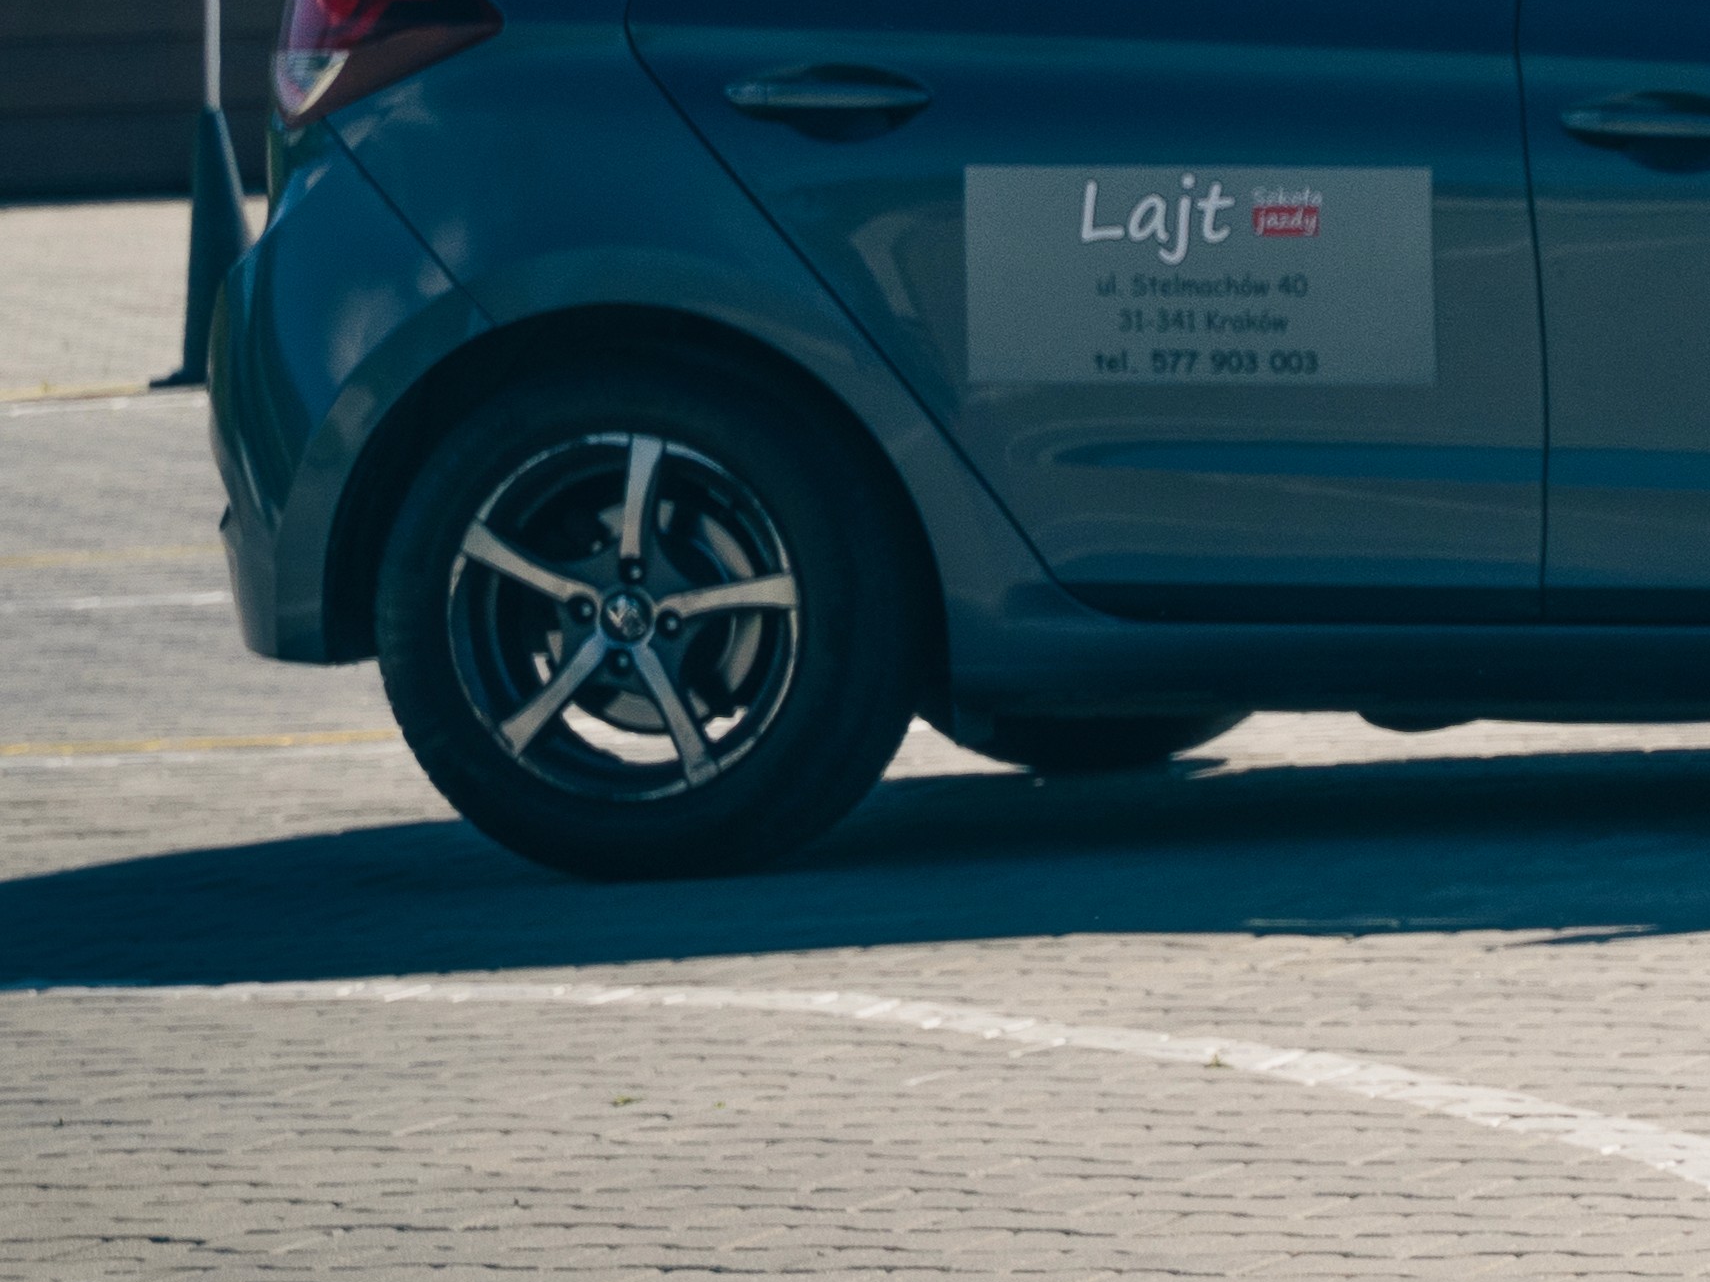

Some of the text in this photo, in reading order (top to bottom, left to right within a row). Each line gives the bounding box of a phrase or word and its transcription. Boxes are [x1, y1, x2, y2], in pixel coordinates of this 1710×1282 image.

[1081, 173, 1235, 265] Lajt
[1253, 207, 1319, 236] jazdy
[1096, 272, 1309, 298] ul. Stelmachów 40
[1118, 307, 1290, 334] 31-341 Kraków
[1094, 349, 1318, 375] tel. 577 903 003
